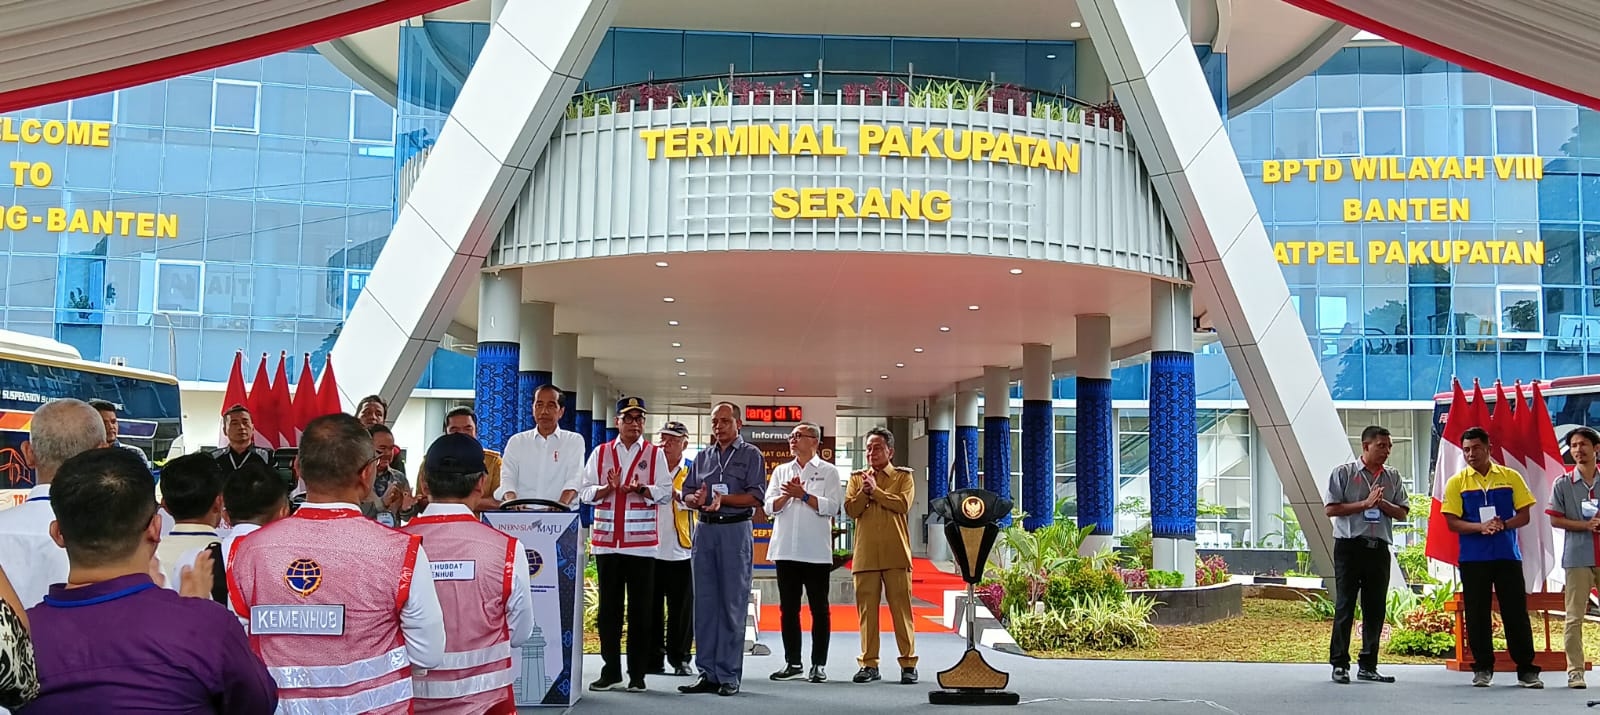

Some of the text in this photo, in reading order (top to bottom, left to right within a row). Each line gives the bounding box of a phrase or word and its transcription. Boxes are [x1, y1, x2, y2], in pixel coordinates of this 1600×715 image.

[0, 117, 110, 147] LCOME
[640, 124, 1080, 174] TERMINAL PAKUPATAN
[10, 161, 53, 188] TO
[1262, 156, 1543, 183] BPTD WILAYAH VIII
[771, 187, 952, 223] SERANG
[1343, 198, 1470, 222] BANTEN
[0, 205, 178, 238] G-BANTEN
[1273, 240, 1545, 265] ATPEL PAKUPATAN
[2, 389, 40, 403] SUSPENSION
[774, 407, 786, 420] di
[537, 524, 562, 535] MAJU
[257, 610, 337, 629] KEMENHUB
